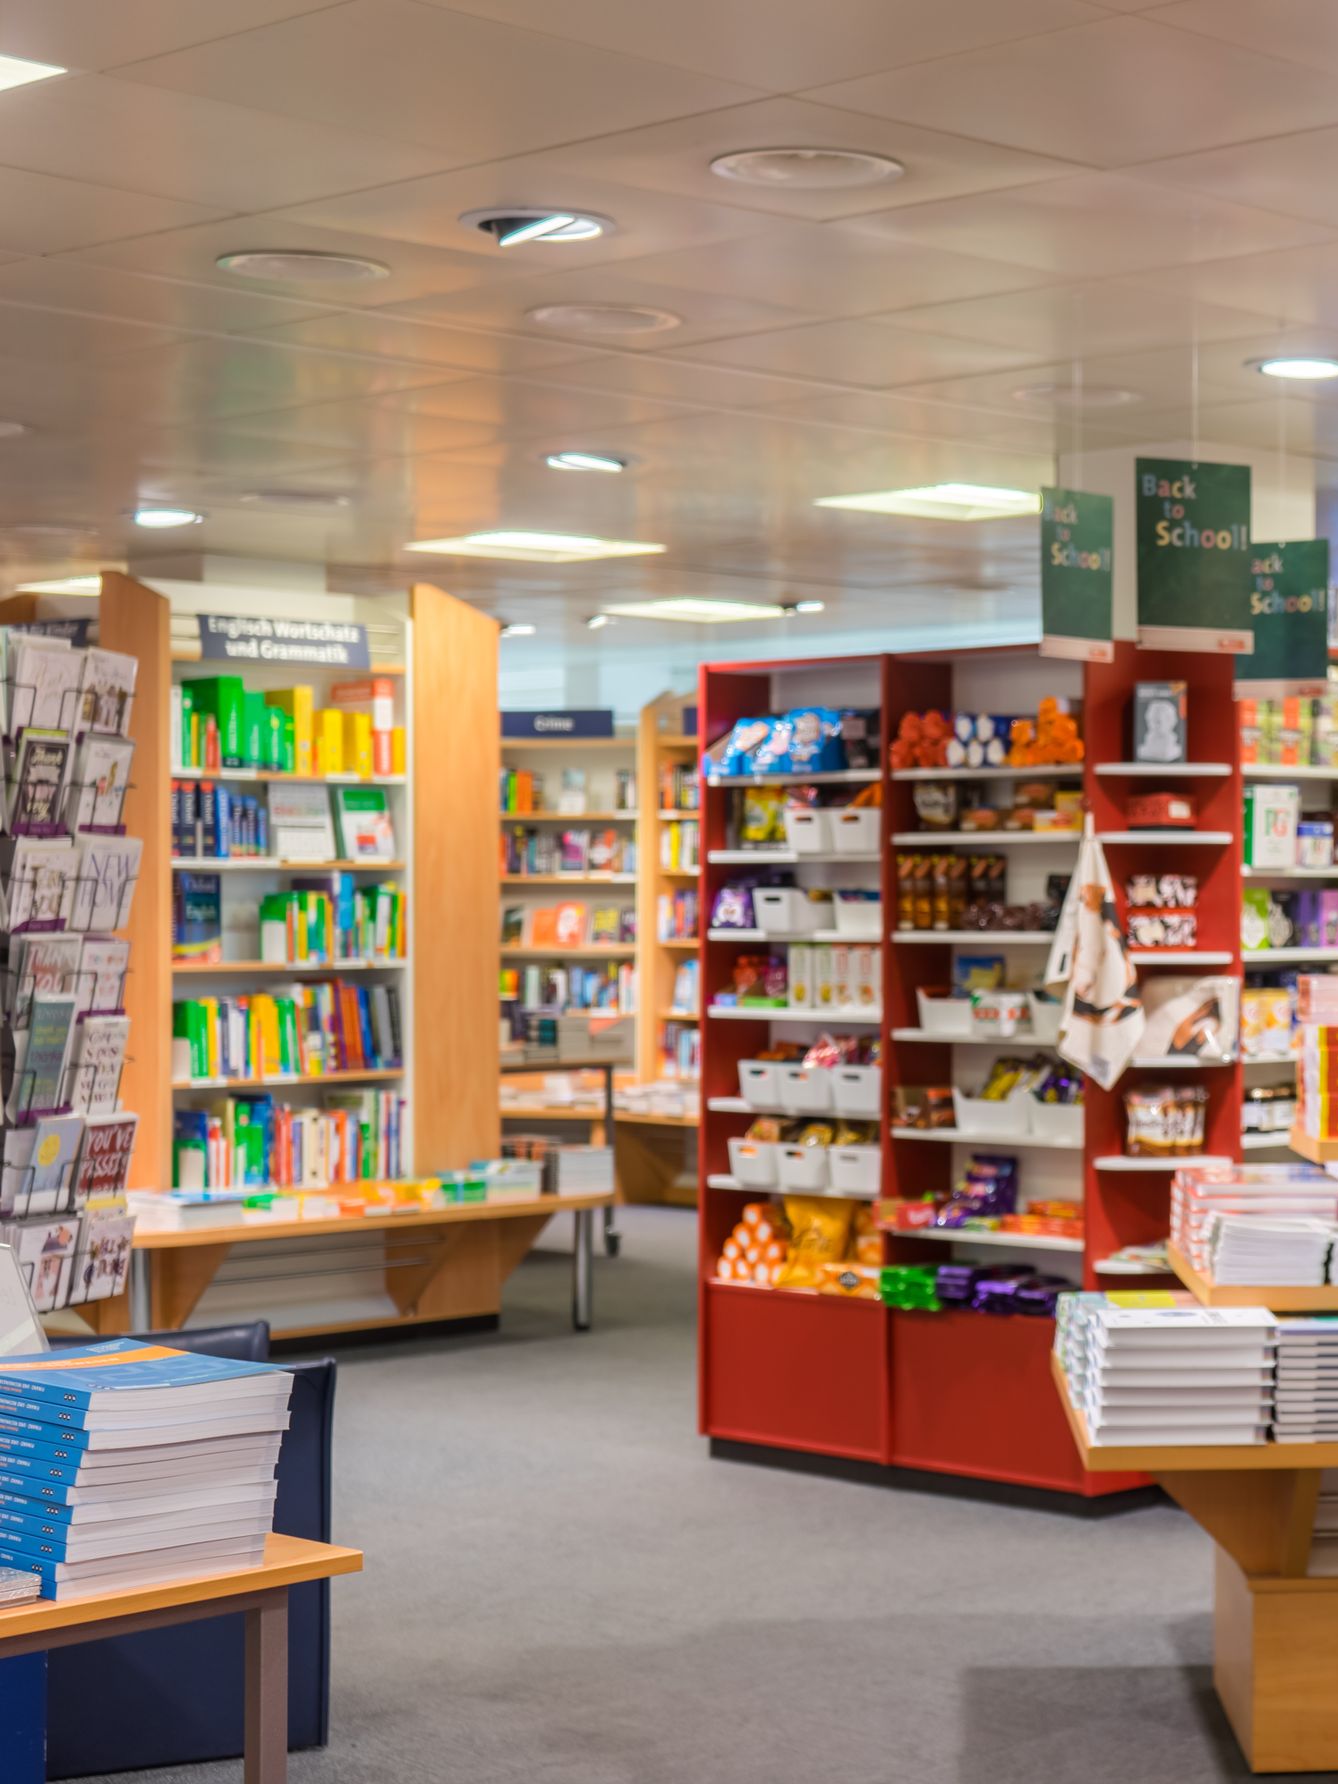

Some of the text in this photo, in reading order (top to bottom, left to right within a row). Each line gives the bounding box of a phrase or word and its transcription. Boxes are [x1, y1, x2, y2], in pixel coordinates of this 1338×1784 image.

[1141, 473, 1197, 500] Back
[1044, 500, 1078, 525] Back
[1163, 500, 1185, 520] to
[1056, 525, 1070, 542] to
[1155, 520, 1248, 551] School!
[1051, 542, 1111, 572] School!
[1251, 554, 1284, 575] ack
[1251, 590, 1326, 615] School!
[208, 616, 274, 638] Englisch
[225, 639, 349, 664] und Grammatik
